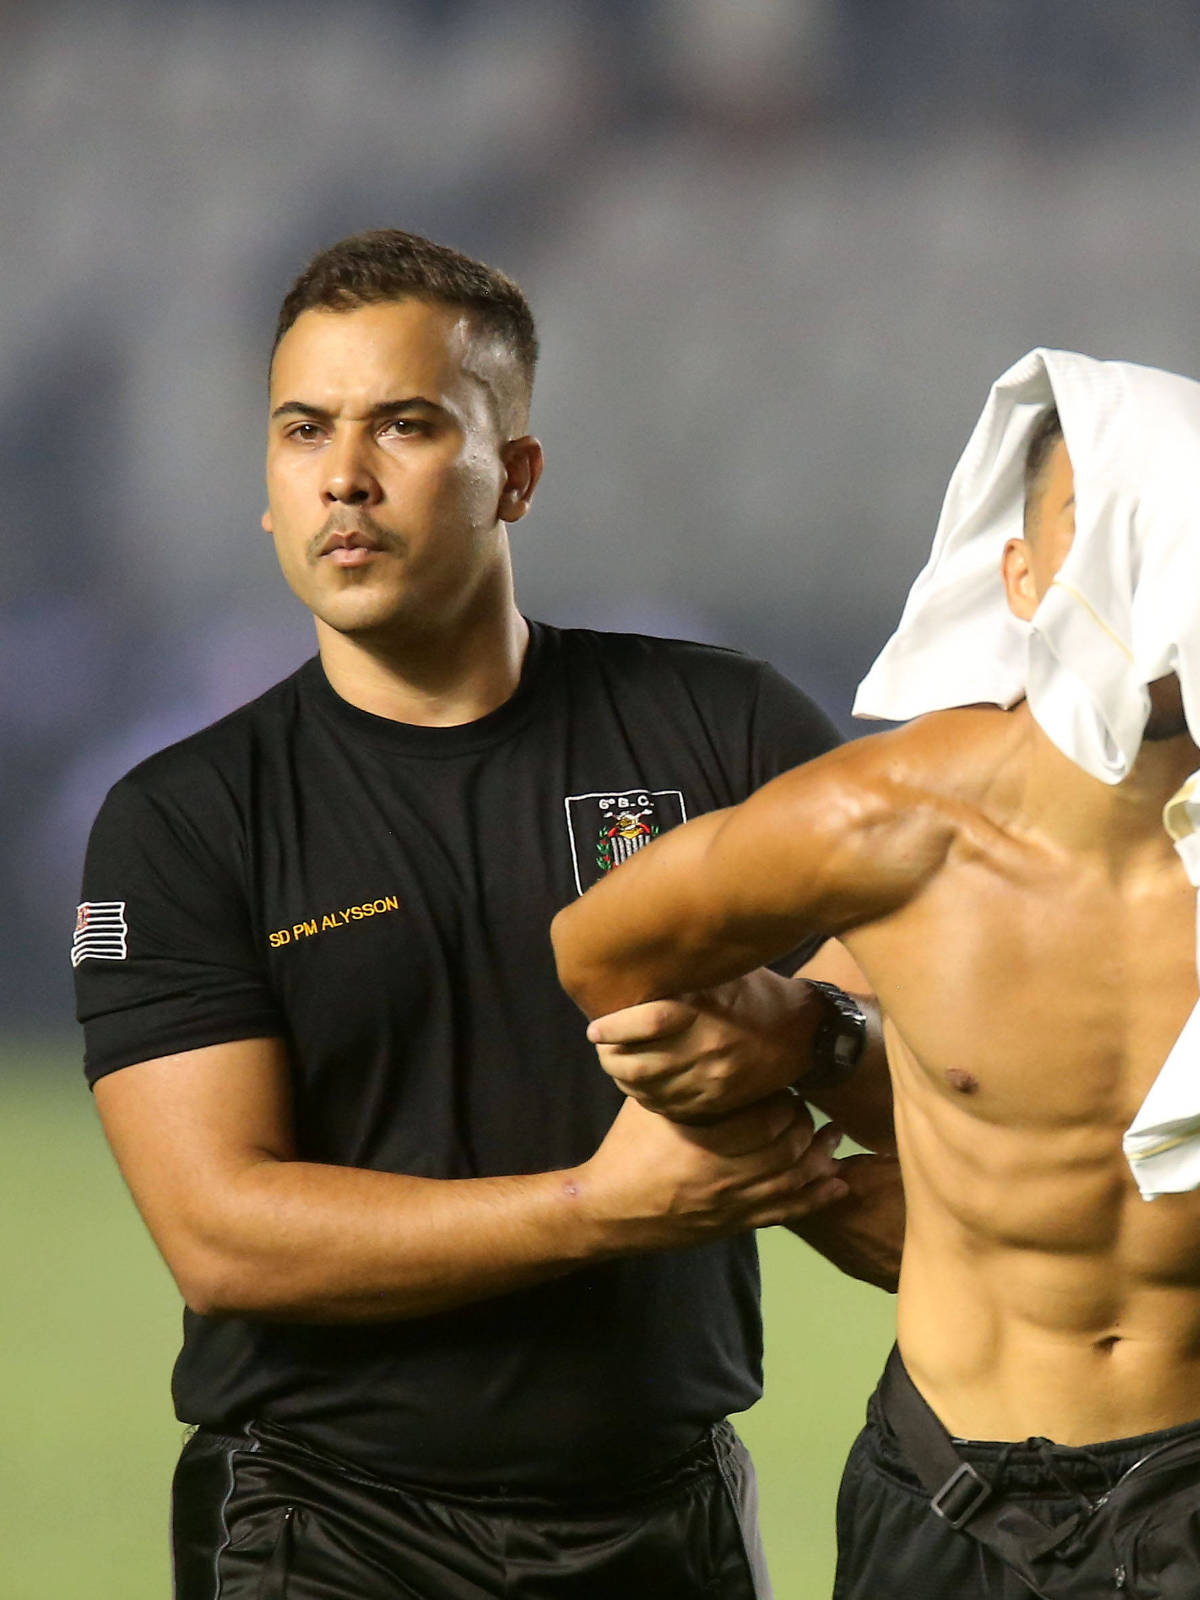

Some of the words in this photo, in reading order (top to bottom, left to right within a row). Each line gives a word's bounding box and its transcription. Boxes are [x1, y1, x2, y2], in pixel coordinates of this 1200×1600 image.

[269, 930, 290, 947] SD
[293, 919, 318, 940] PM
[322, 896, 399, 930] ALYSSON
